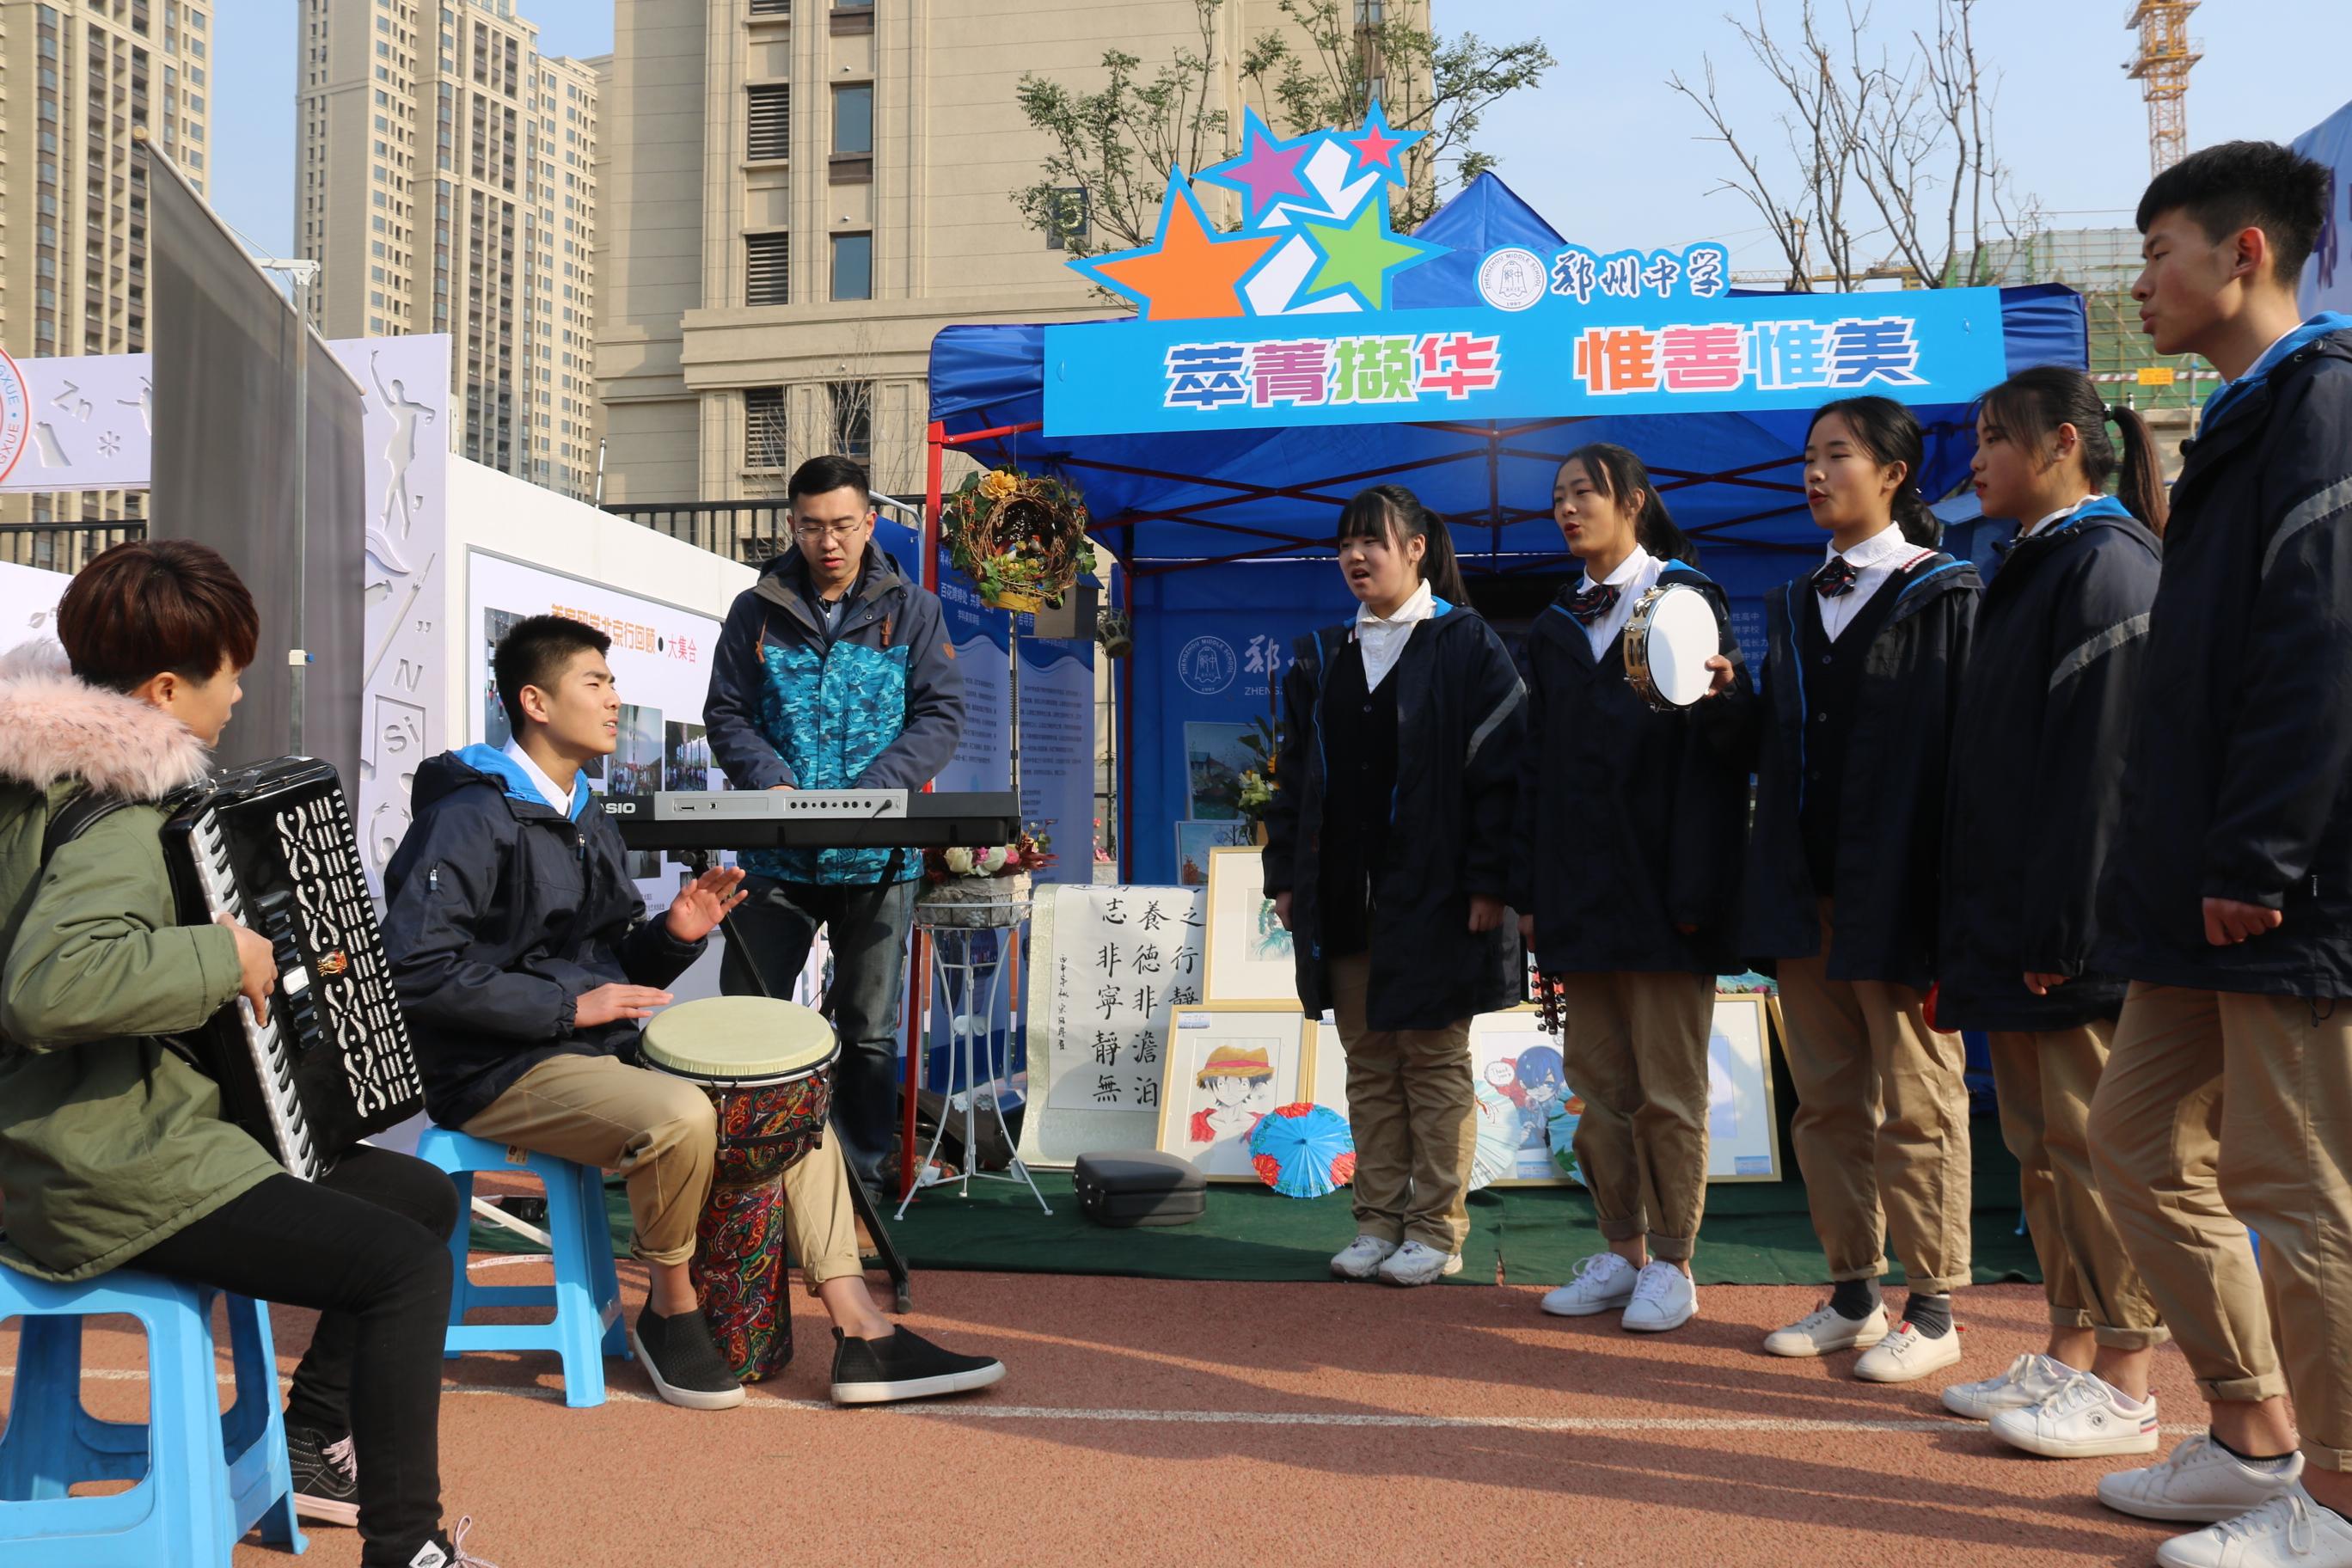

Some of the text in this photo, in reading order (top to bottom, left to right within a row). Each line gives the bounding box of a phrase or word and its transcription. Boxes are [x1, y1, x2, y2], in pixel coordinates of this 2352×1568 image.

[1505, 254, 1529, 262] MIDDLE
[1530, 262, 1541, 288] SCHOOL
[1552, 251, 1722, 303] 郑州中学
[1166, 319, 1922, 407] 萃菁撷华 惟善惟美
[51, 379, 93, 422] Zn
[668, 634, 697, 663] 大集合
[383, 716, 420, 755] Si
